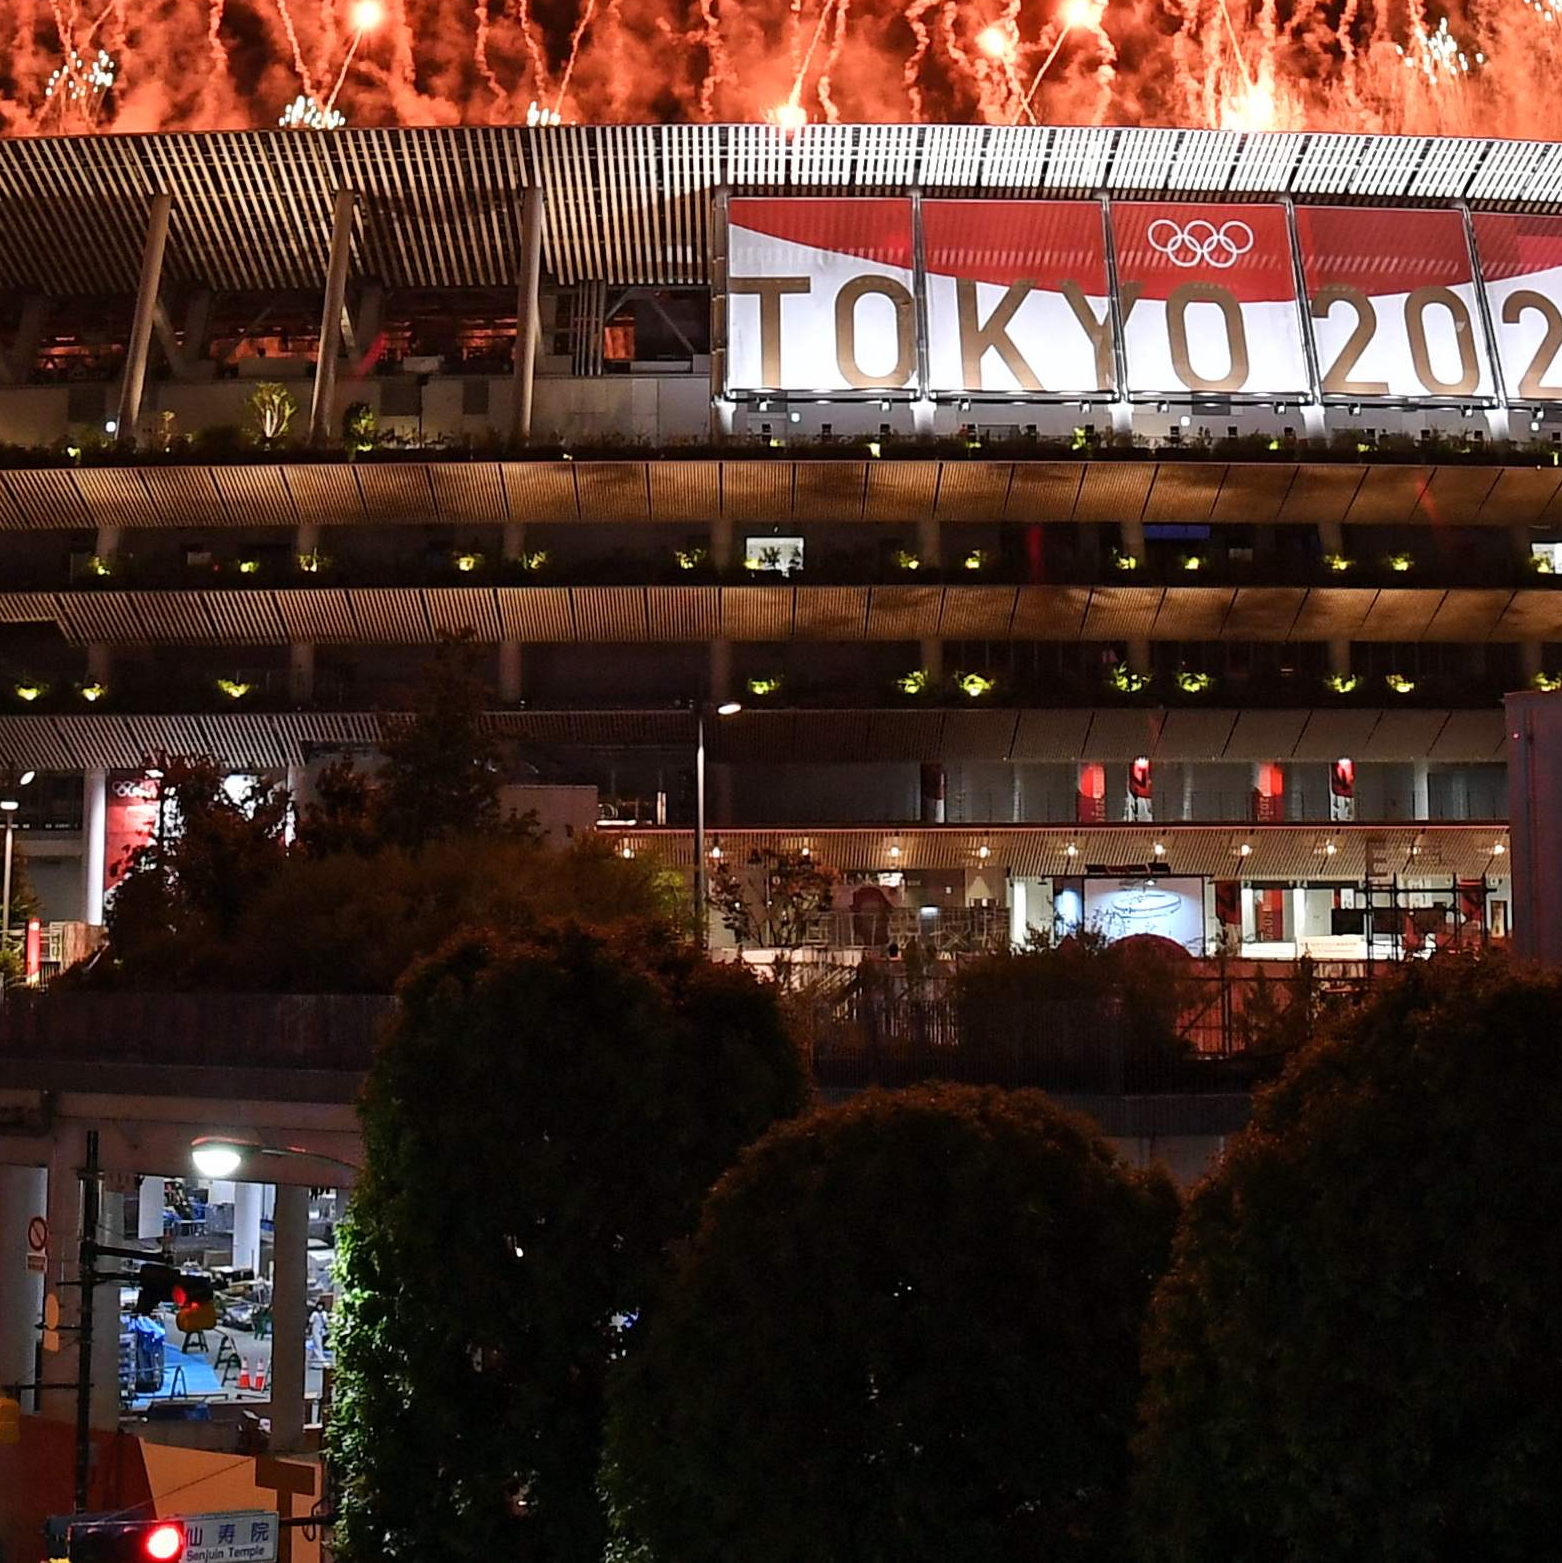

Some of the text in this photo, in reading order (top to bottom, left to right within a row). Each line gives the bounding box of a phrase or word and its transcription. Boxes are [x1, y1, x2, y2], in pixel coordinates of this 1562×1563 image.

[729, 274, 1250, 392] TOKYO
[186, 1522, 269, 1546] 仙寿院
[187, 1545, 264, 1563] Senjuin Temple
